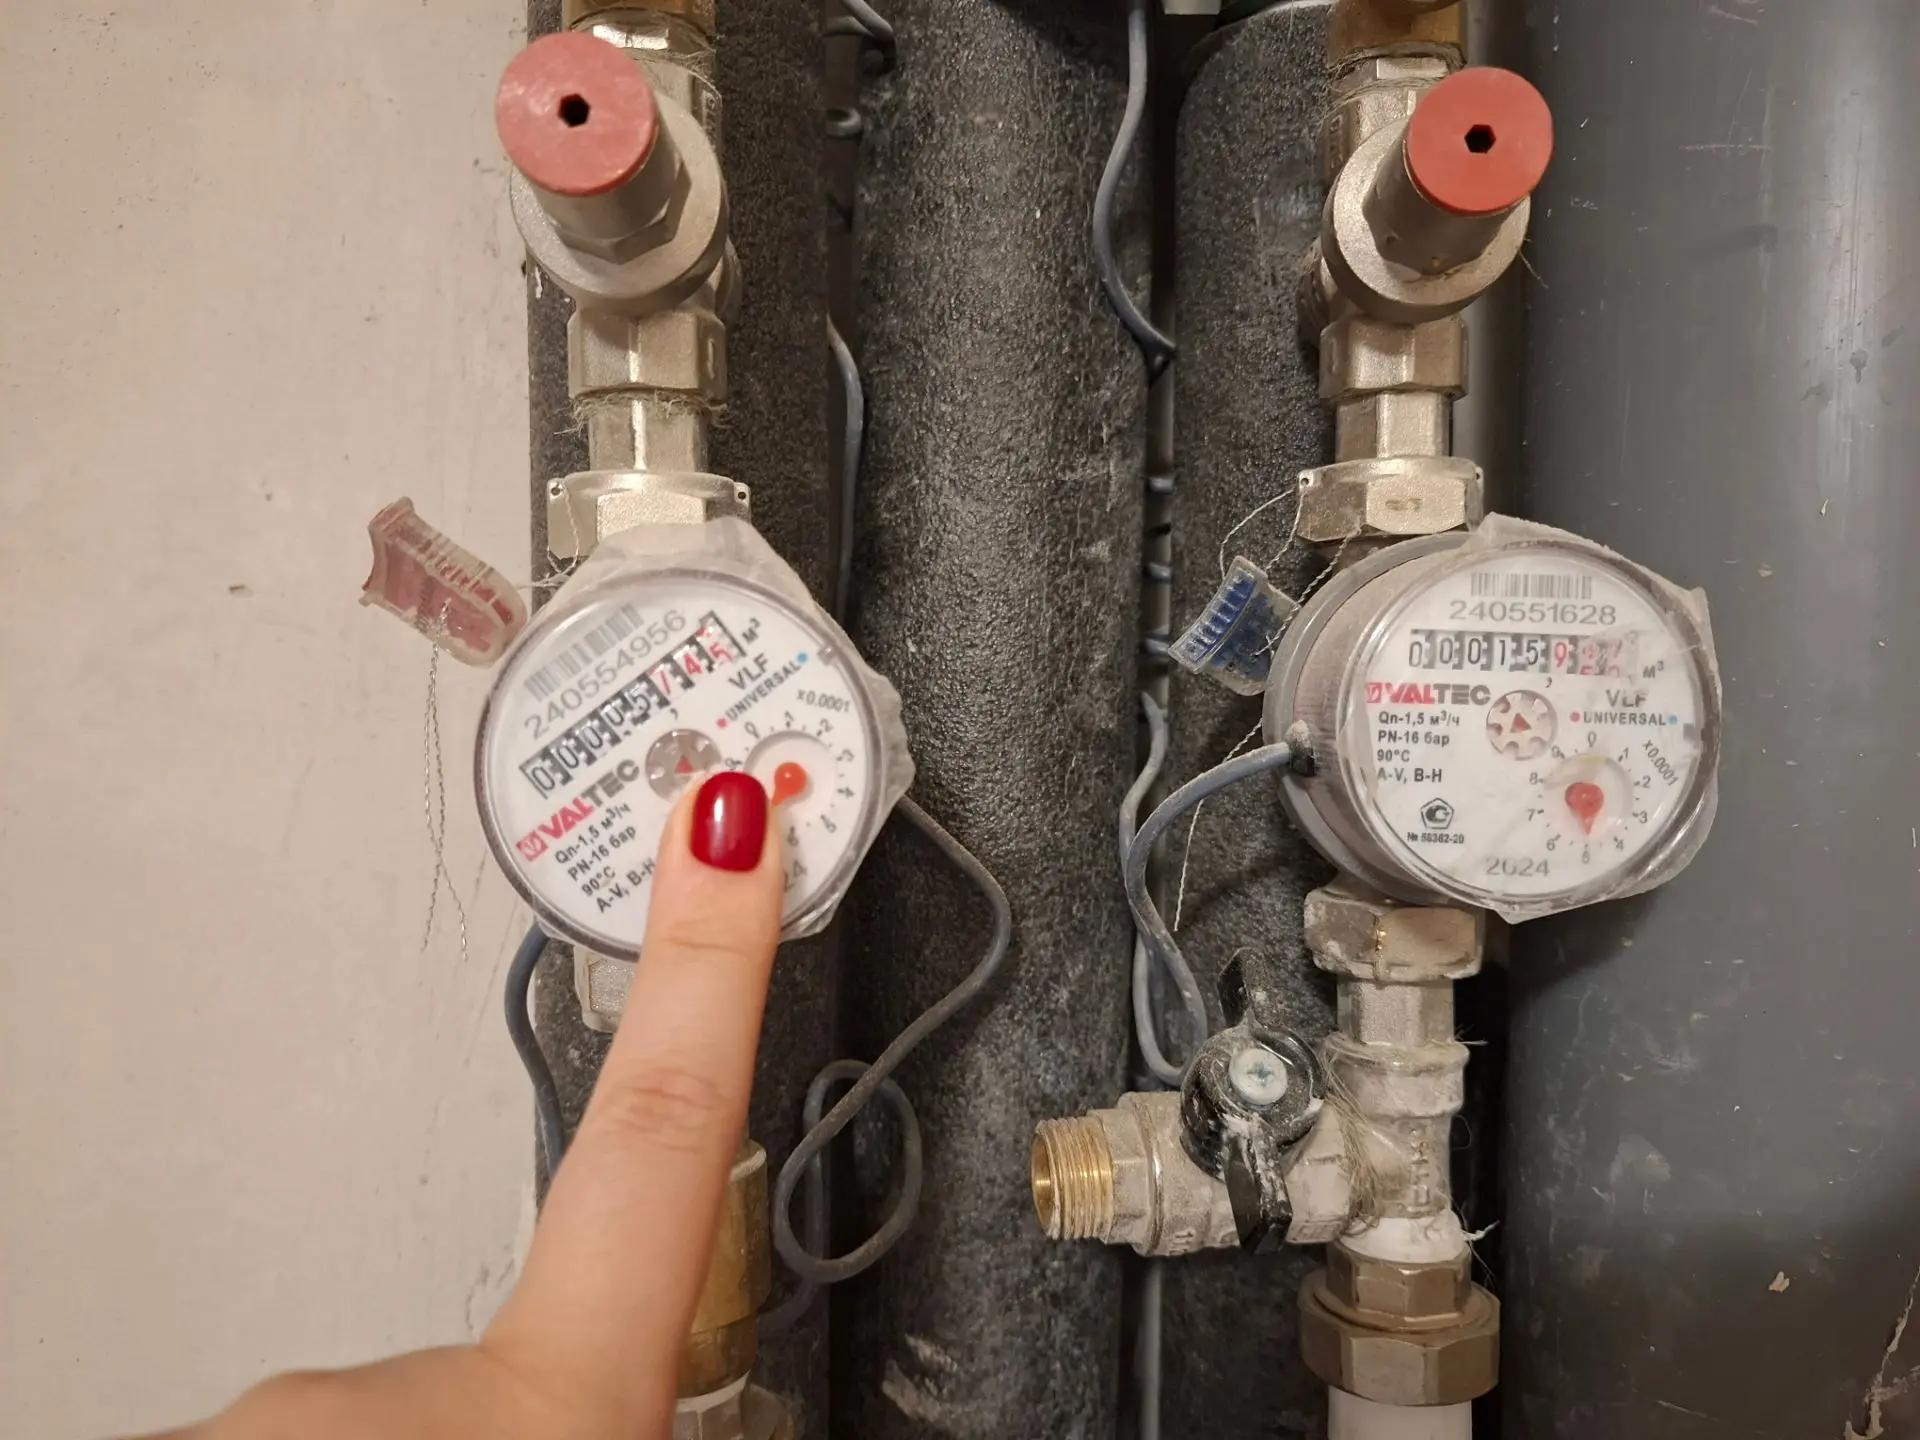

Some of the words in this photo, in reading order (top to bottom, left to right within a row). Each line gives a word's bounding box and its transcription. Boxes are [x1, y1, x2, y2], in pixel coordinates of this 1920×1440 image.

[1449, 600, 1617, 625] 240551628
[524, 609, 687, 740] 240554956
[728, 652, 769, 690] VLF
[725, 660, 802, 722] UNIVERSAL
[1384, 682, 1491, 706] VALTEC
[1605, 687, 1649, 708] VLF
[1378, 710, 1425, 727] Qn-1,5
[1583, 711, 1667, 727] UNIVERSAL
[1377, 730, 1419, 745] PN-16
[1424, 730, 1450, 747] бар
[1376, 748, 1411, 762] 90°C
[1376, 767, 1408, 785] A-V,
[1413, 767, 1443, 783] B-H
[1641, 775, 1651, 789] 2
[537, 758, 641, 840] VALTEC
[1527, 808, 1536, 822] 7
[554, 825, 600, 865] Qn-1,5
[567, 845, 610, 881] PN-16
[608, 825, 637, 850] бар
[1485, 858, 1550, 878] 2024
[581, 865, 617, 897] 90°C
[596, 882, 631, 914] A-V,
